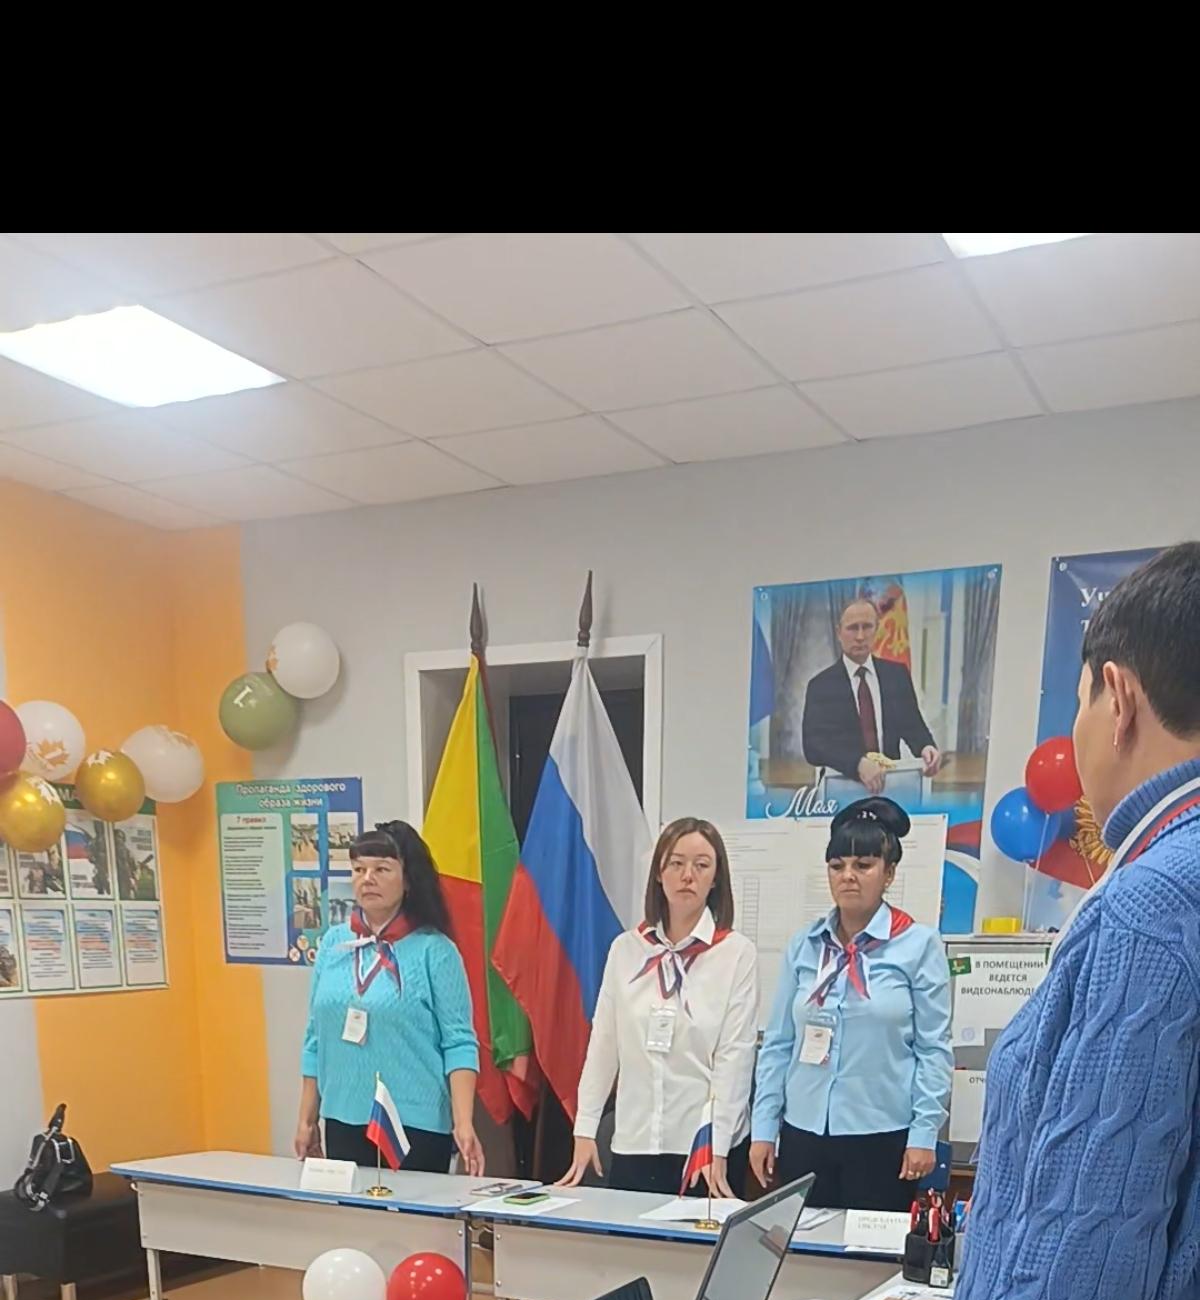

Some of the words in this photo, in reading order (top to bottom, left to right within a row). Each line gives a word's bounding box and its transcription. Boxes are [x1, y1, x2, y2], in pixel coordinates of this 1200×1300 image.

[236, 784, 291, 795] Пропаганда
[295, 782, 346, 794] здорового
[258, 798, 291, 809] образа
[293, 798, 323, 808] жизни
[975, 960, 981, 968] В
[983, 960, 1044, 969] ПОМЕЩЕНИИ
[989, 974, 1027, 983] ВЕДЕТСЯ
[961, 987, 1034, 996] ВИДЕОНАБЛЮД
